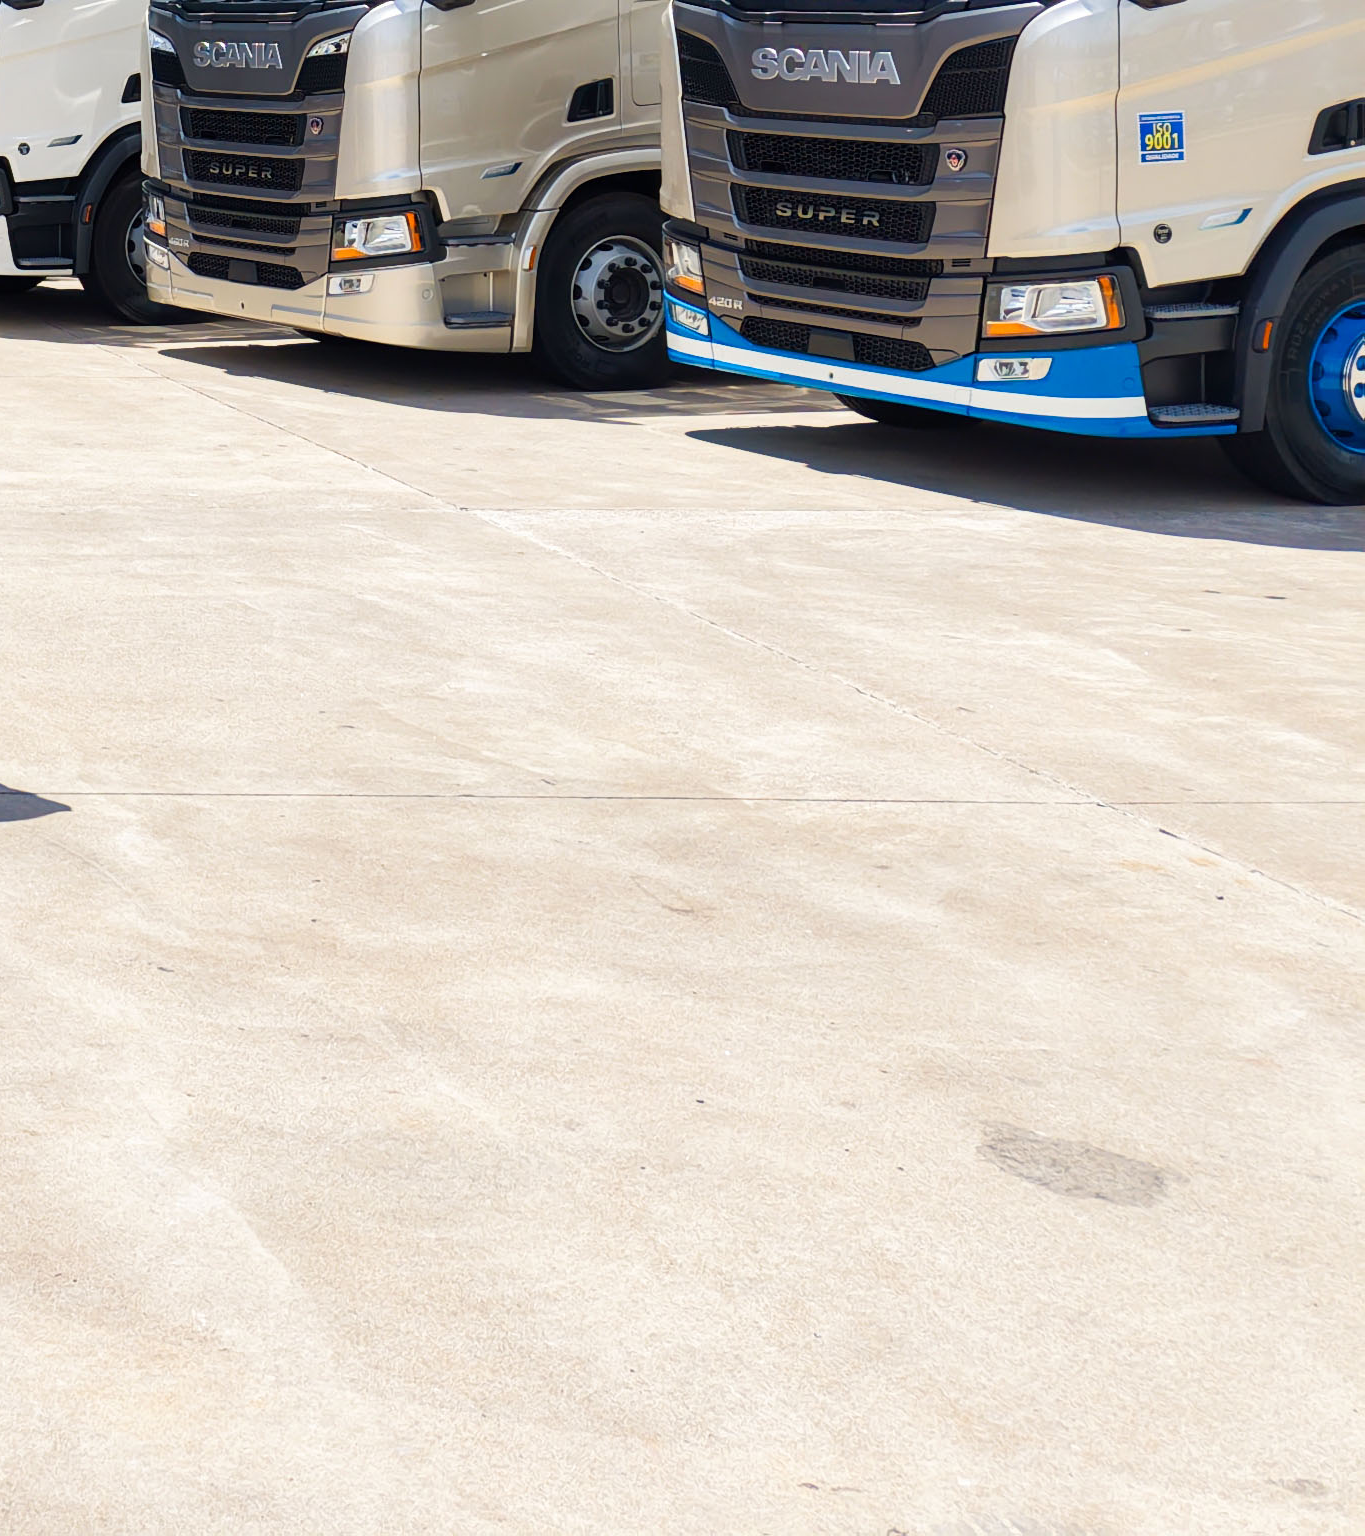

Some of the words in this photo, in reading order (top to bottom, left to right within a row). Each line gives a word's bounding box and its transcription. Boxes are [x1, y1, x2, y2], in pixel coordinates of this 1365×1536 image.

[193, 41, 283, 70] SCANIA
[750, 47, 901, 85] SCANIA
[1153, 122, 1172, 136] ISO
[1144, 132, 1179, 151] 9001
[209, 162, 273, 179] SUPER
[775, 202, 881, 227] SUPER
